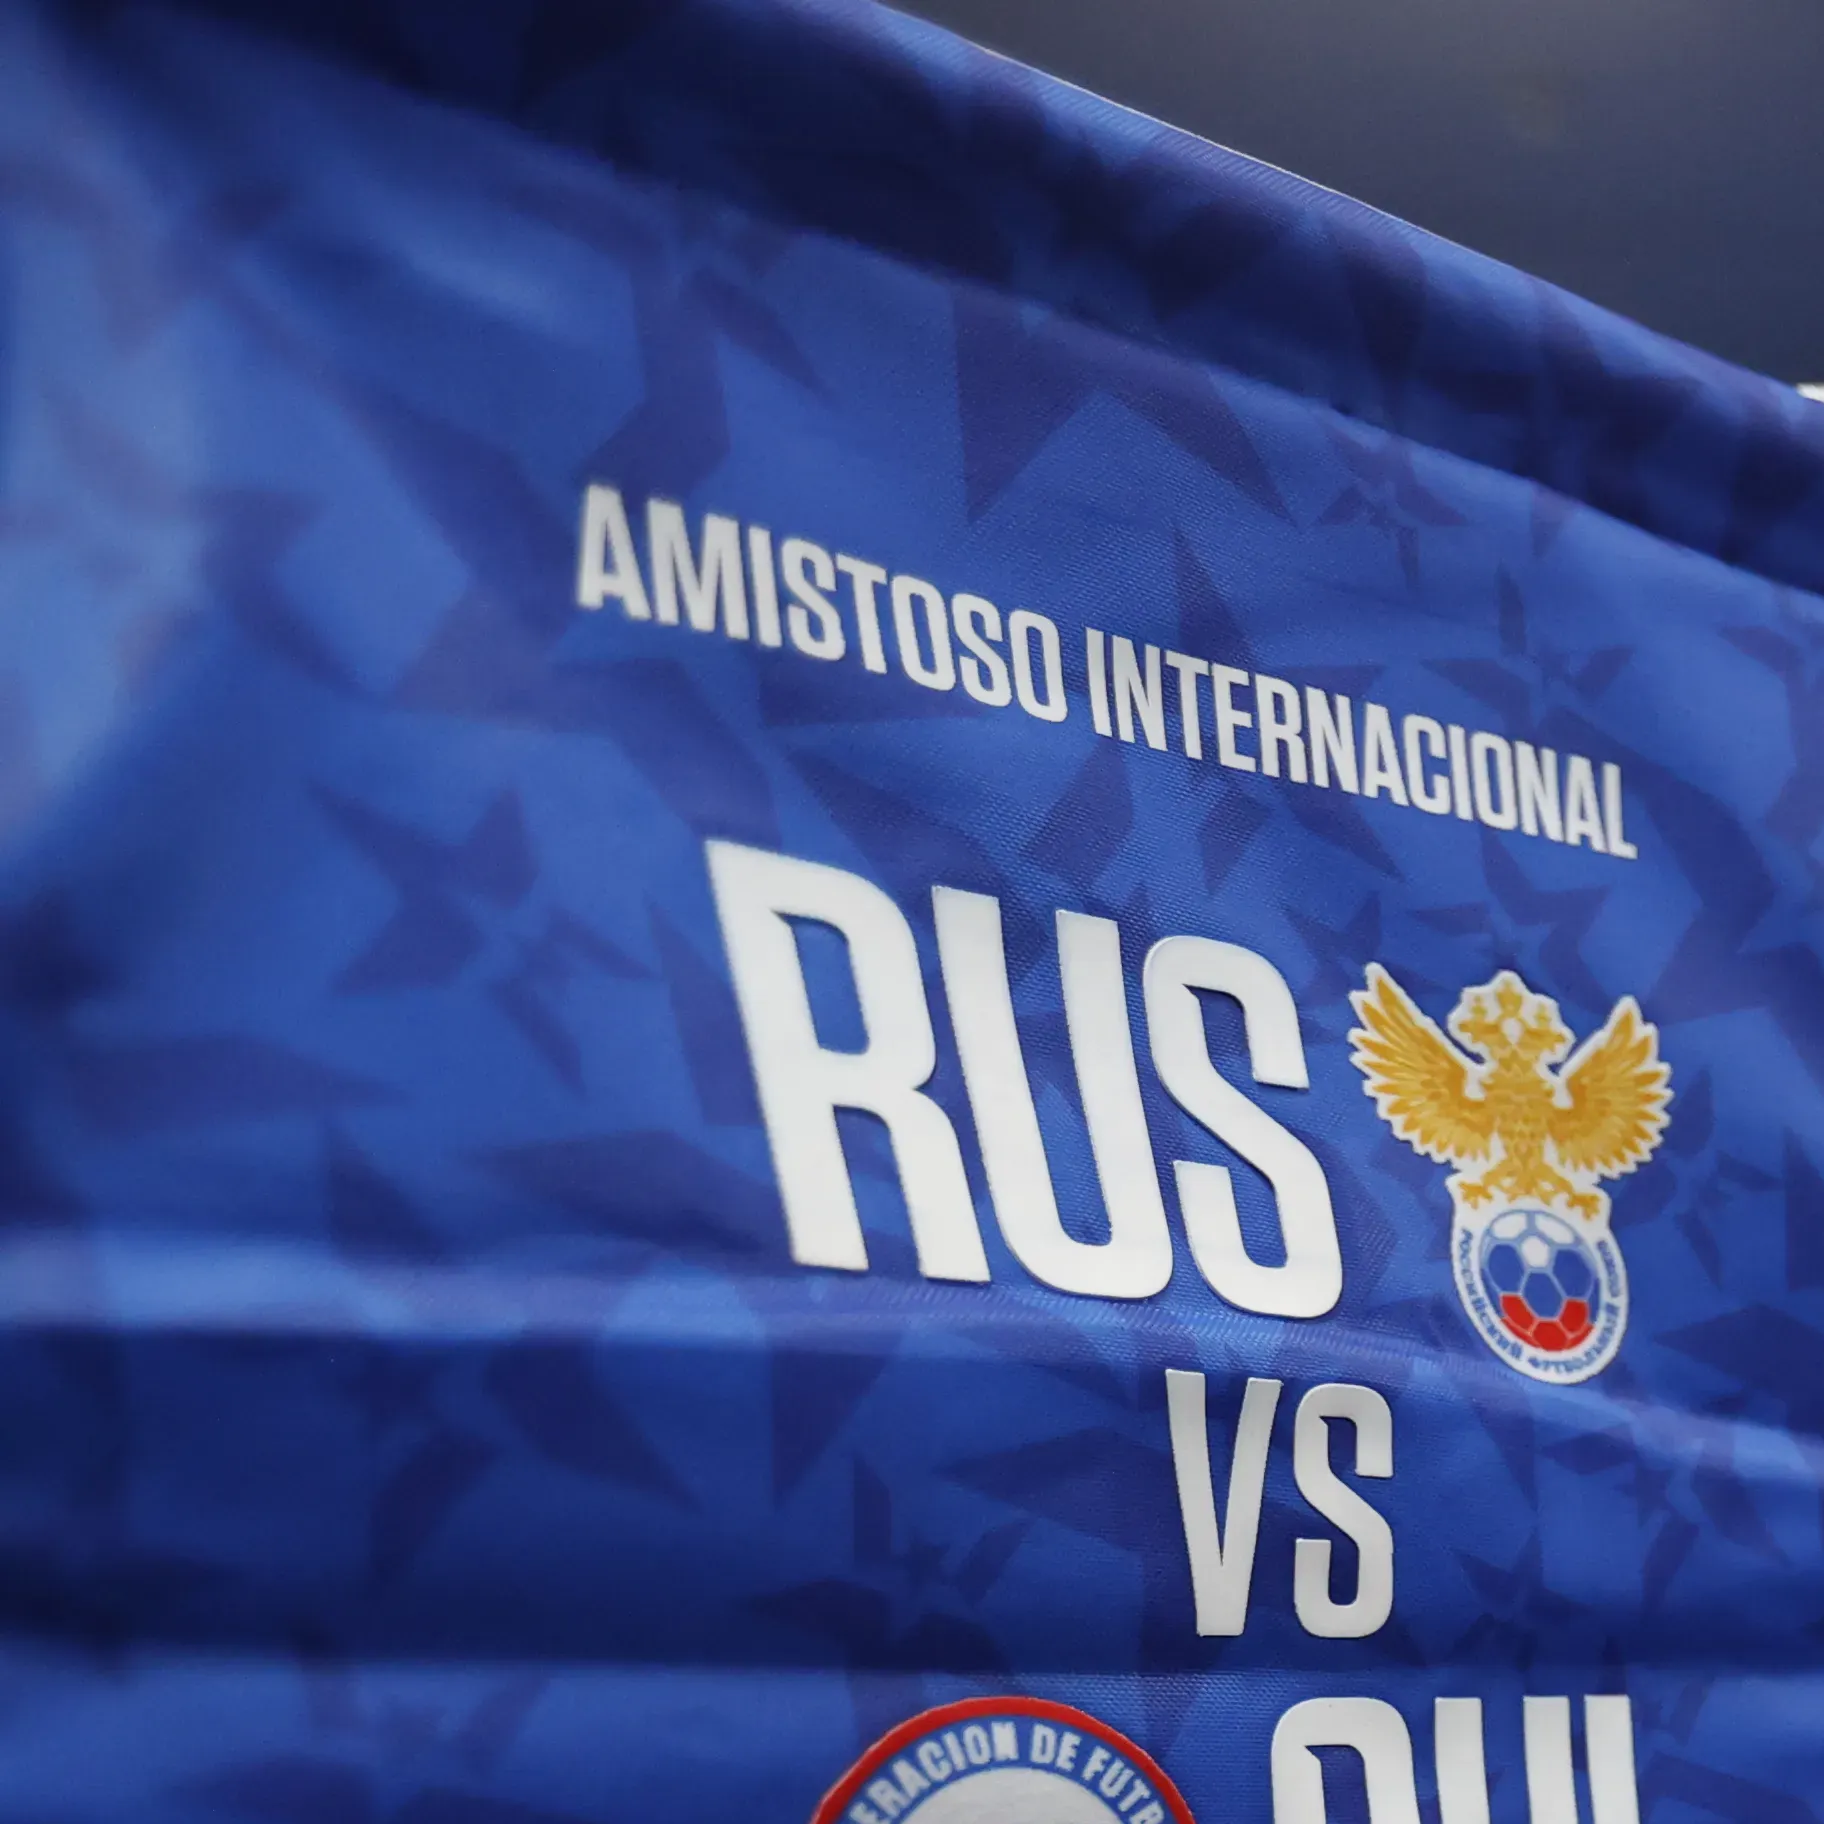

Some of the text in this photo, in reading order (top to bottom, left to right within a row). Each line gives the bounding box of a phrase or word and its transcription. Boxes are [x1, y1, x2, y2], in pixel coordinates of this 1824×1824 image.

[577, 484, 1638, 860] AMISTOSO INTERNACIONAL
[704, 838, 1344, 1319] RUS
[1165, 1368, 1394, 1639] VS
[1030, 1722, 1082, 1772] DE
